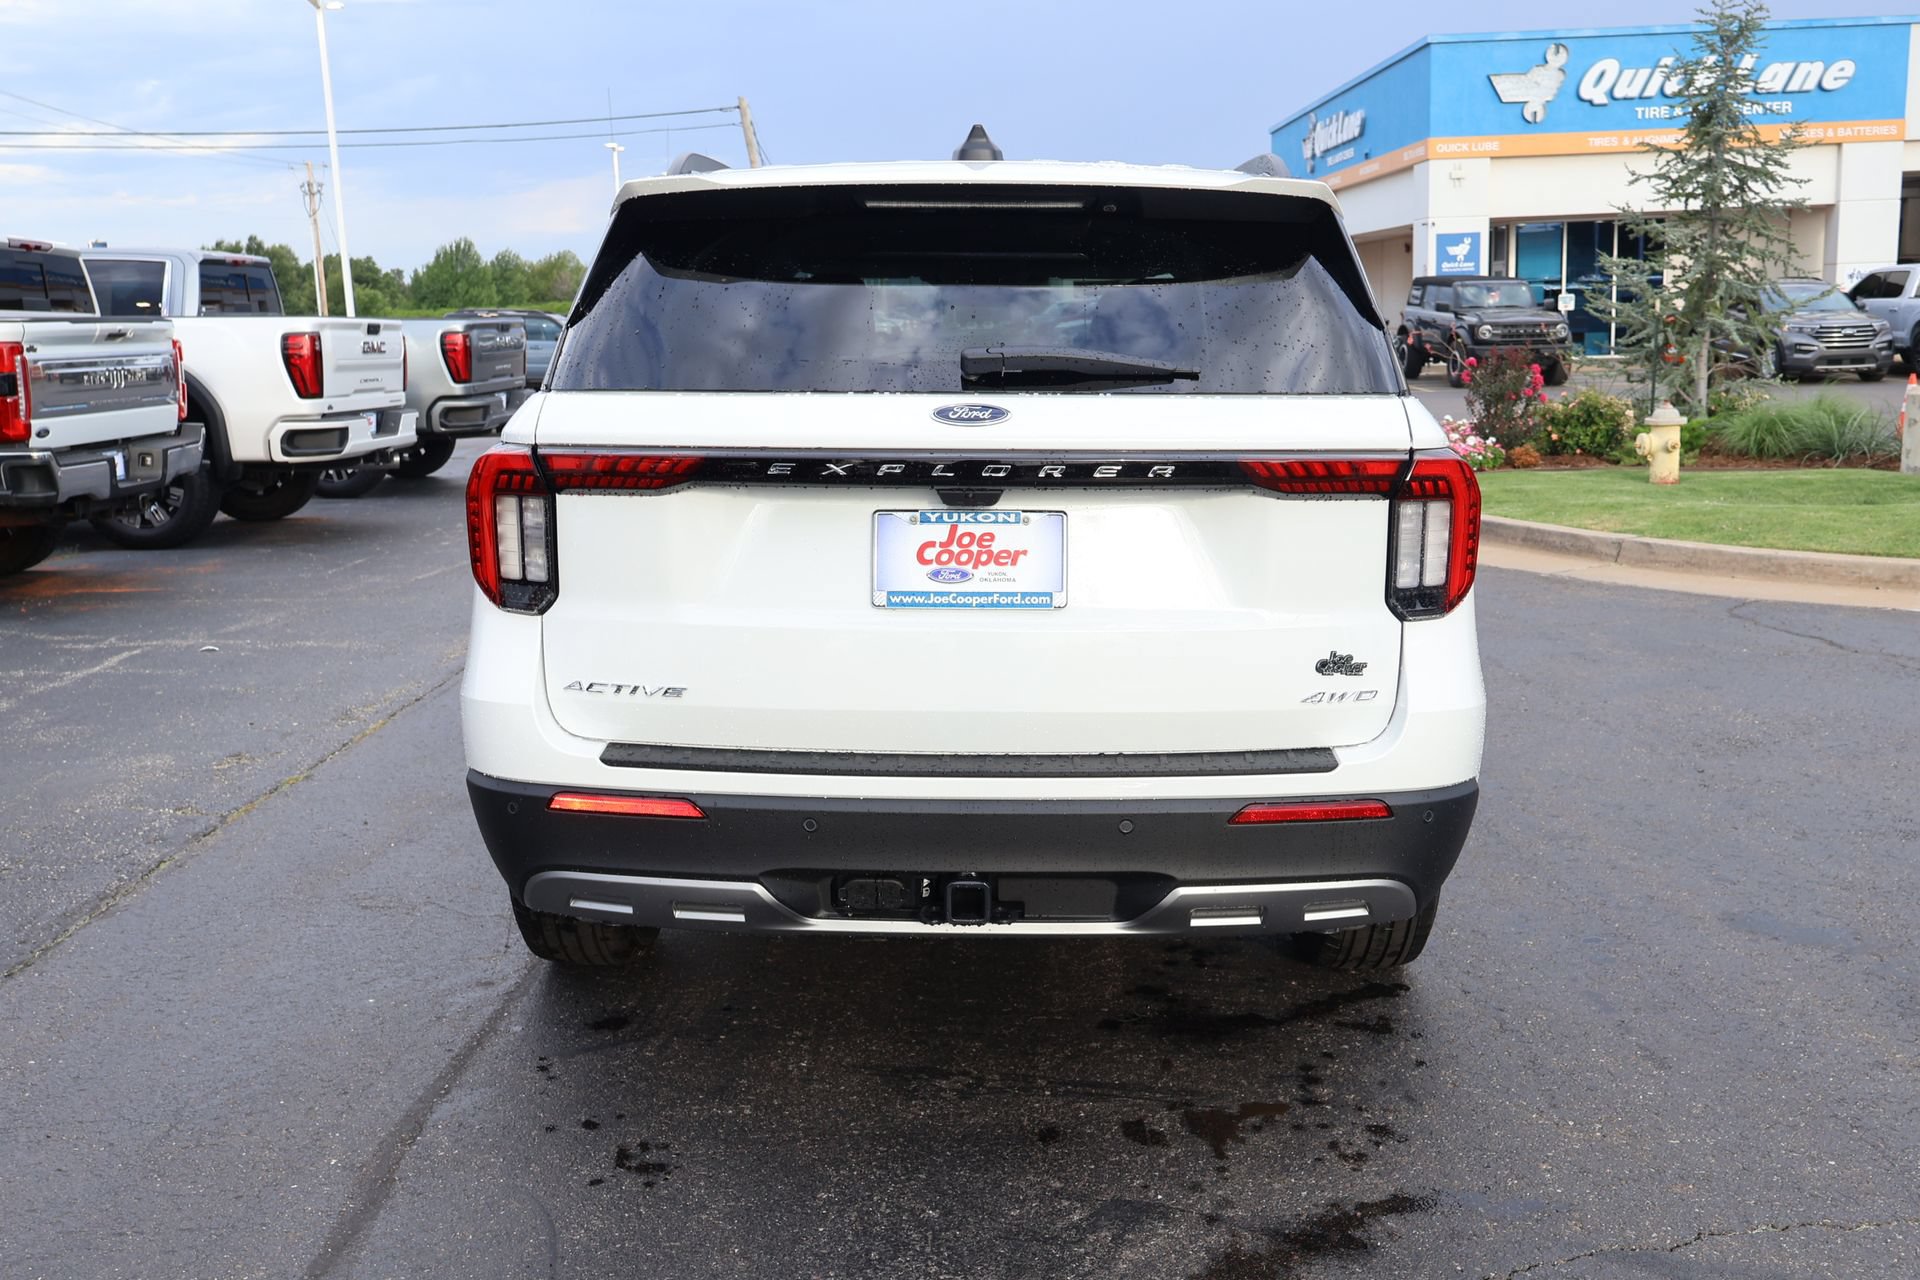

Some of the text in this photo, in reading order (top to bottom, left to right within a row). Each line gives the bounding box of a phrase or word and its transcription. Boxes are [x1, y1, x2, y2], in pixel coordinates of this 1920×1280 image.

[1726, 54, 1856, 95] Lane
[1635, 105, 1670, 119] TIRE
[1826, 127, 1834, 138] &
[1837, 125, 1898, 138] BATTERIES
[1436, 143, 1470, 153] QUICK
[1471, 141, 1500, 151] LUBE
[1587, 136, 1618, 147] TIRES
[362, 340, 387, 354] GMC
[767, 463, 1176, 478] EXPLORER
[926, 512, 1017, 523] YUKON
[939, 524, 996, 549] Joe
[916, 541, 1028, 569] Cooper
[889, 592, 1051, 607] www.JoeCooperFord.com
[563, 680, 688, 698] ACTIVE
[1301, 690, 1378, 703] 4WD
